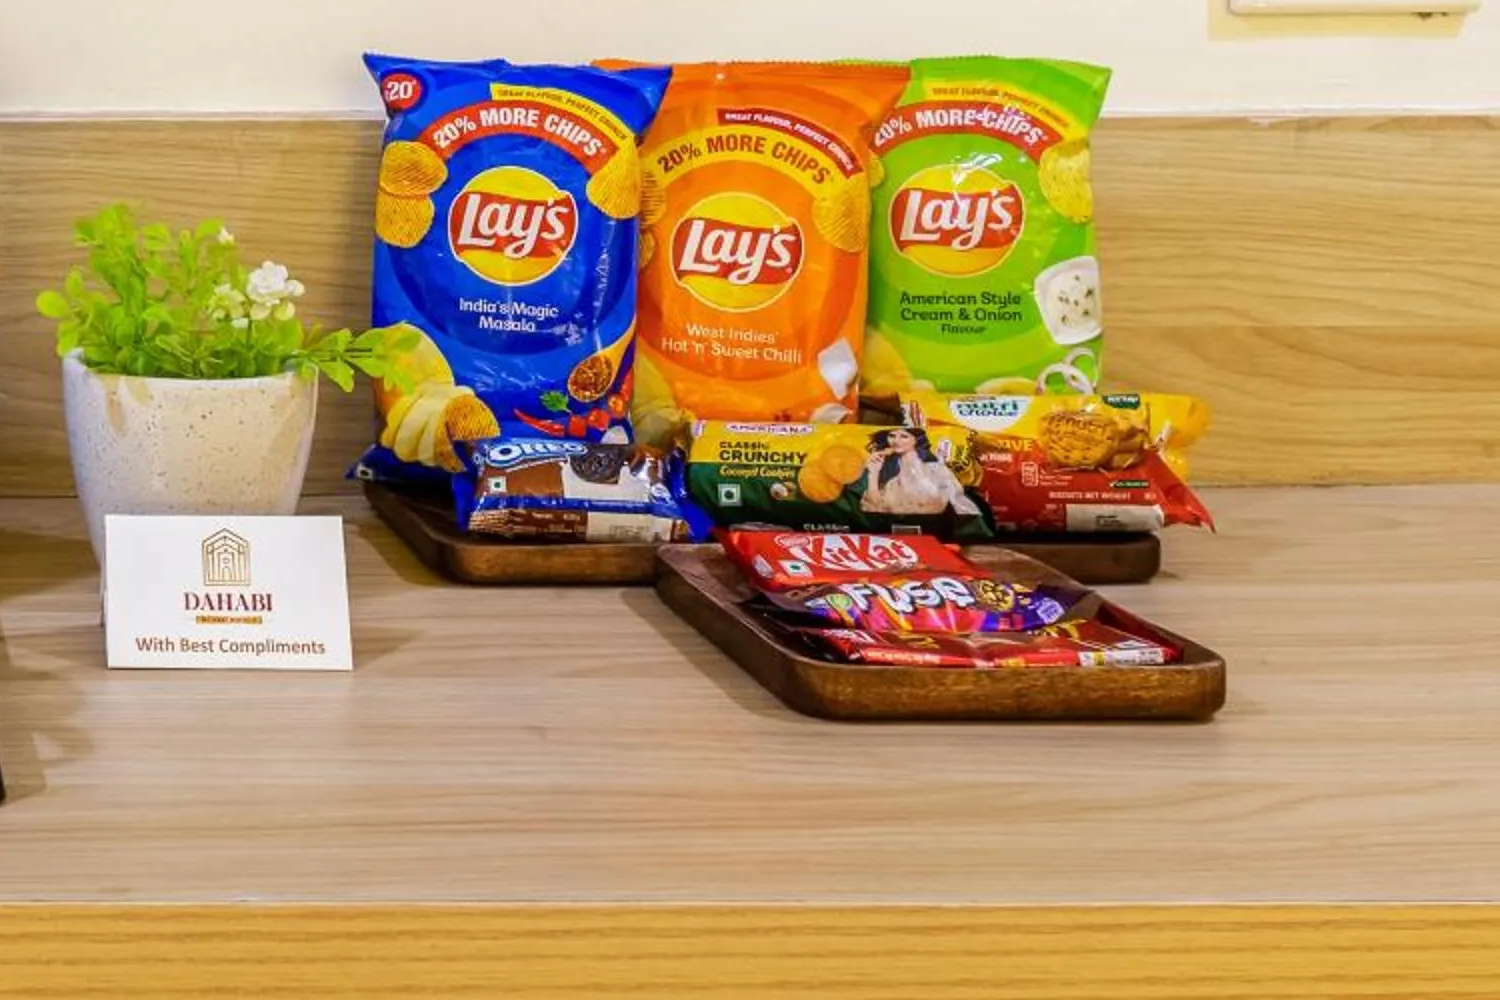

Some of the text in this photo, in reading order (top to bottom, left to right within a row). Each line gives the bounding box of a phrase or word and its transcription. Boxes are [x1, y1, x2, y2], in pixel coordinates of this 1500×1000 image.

[432, 115, 477, 150] 20%
[479, 107, 541, 128] MORE
[915, 109, 977, 129] MORE
[657, 142, 704, 174] 20%
[706, 133, 767, 155] MORE
[457, 193, 570, 259] Lay's
[899, 189, 1015, 251] Lay's
[677, 219, 797, 285] Lay's
[459, 298, 560, 321] India's Magic
[900, 291, 1022, 309] American Style
[479, 316, 536, 333] Masala
[900, 307, 1023, 322] Cream & Onion
[686, 322, 724, 340] West
[940, 323, 987, 334] Flavour
[661, 337, 689, 353] Hot
[711, 342, 760, 360] Sweet
[763, 347, 803, 365] Chilli
[719, 449, 808, 464] CRUNCHY
[183, 592, 273, 612] DAHABI
[135, 636, 326, 657] With Best Compliments
